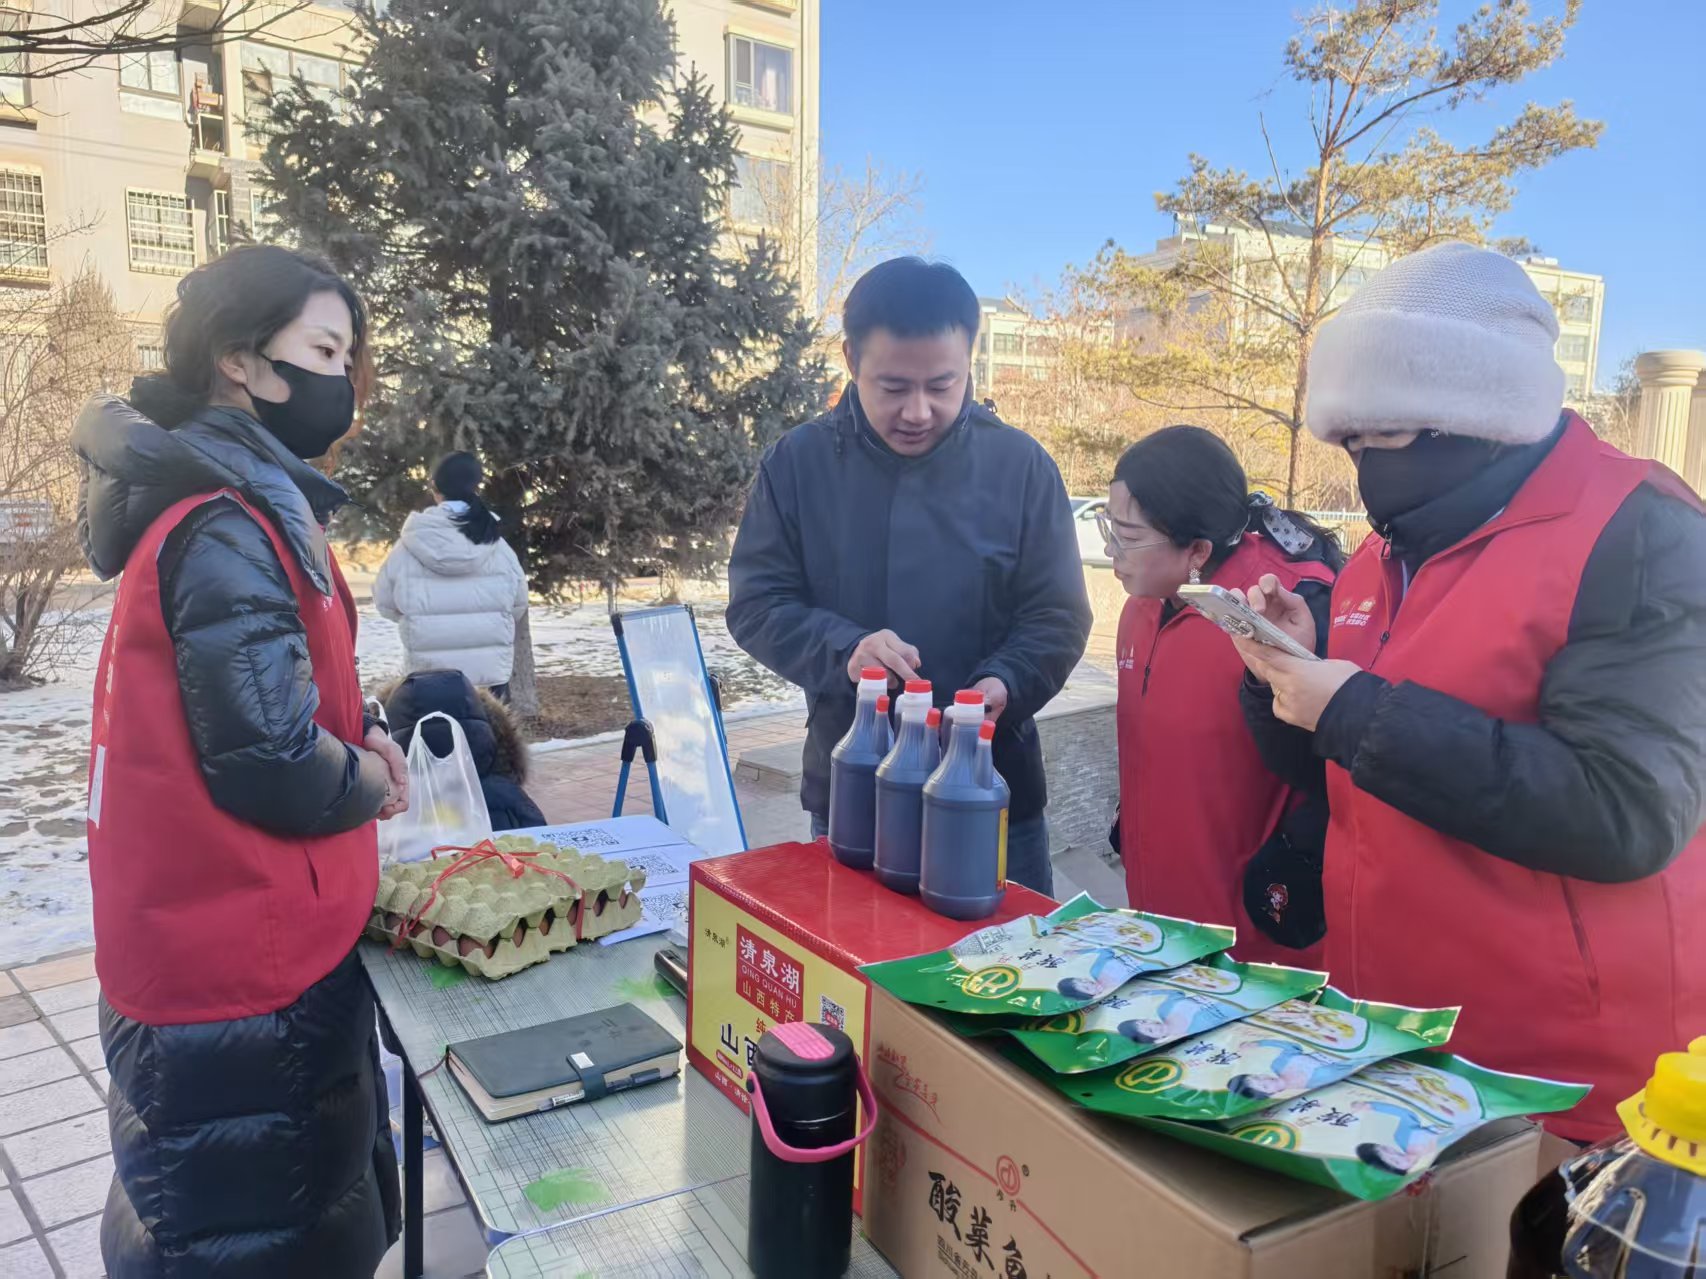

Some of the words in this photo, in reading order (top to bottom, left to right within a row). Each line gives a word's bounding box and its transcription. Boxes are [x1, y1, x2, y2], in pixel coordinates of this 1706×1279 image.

[740, 936, 800, 994] 清泉湖
[741, 964, 760, 983] QING
[762, 979, 784, 1000] QUAN
[785, 995, 797, 1009] HU
[742, 979, 796, 1023] 山西特产
